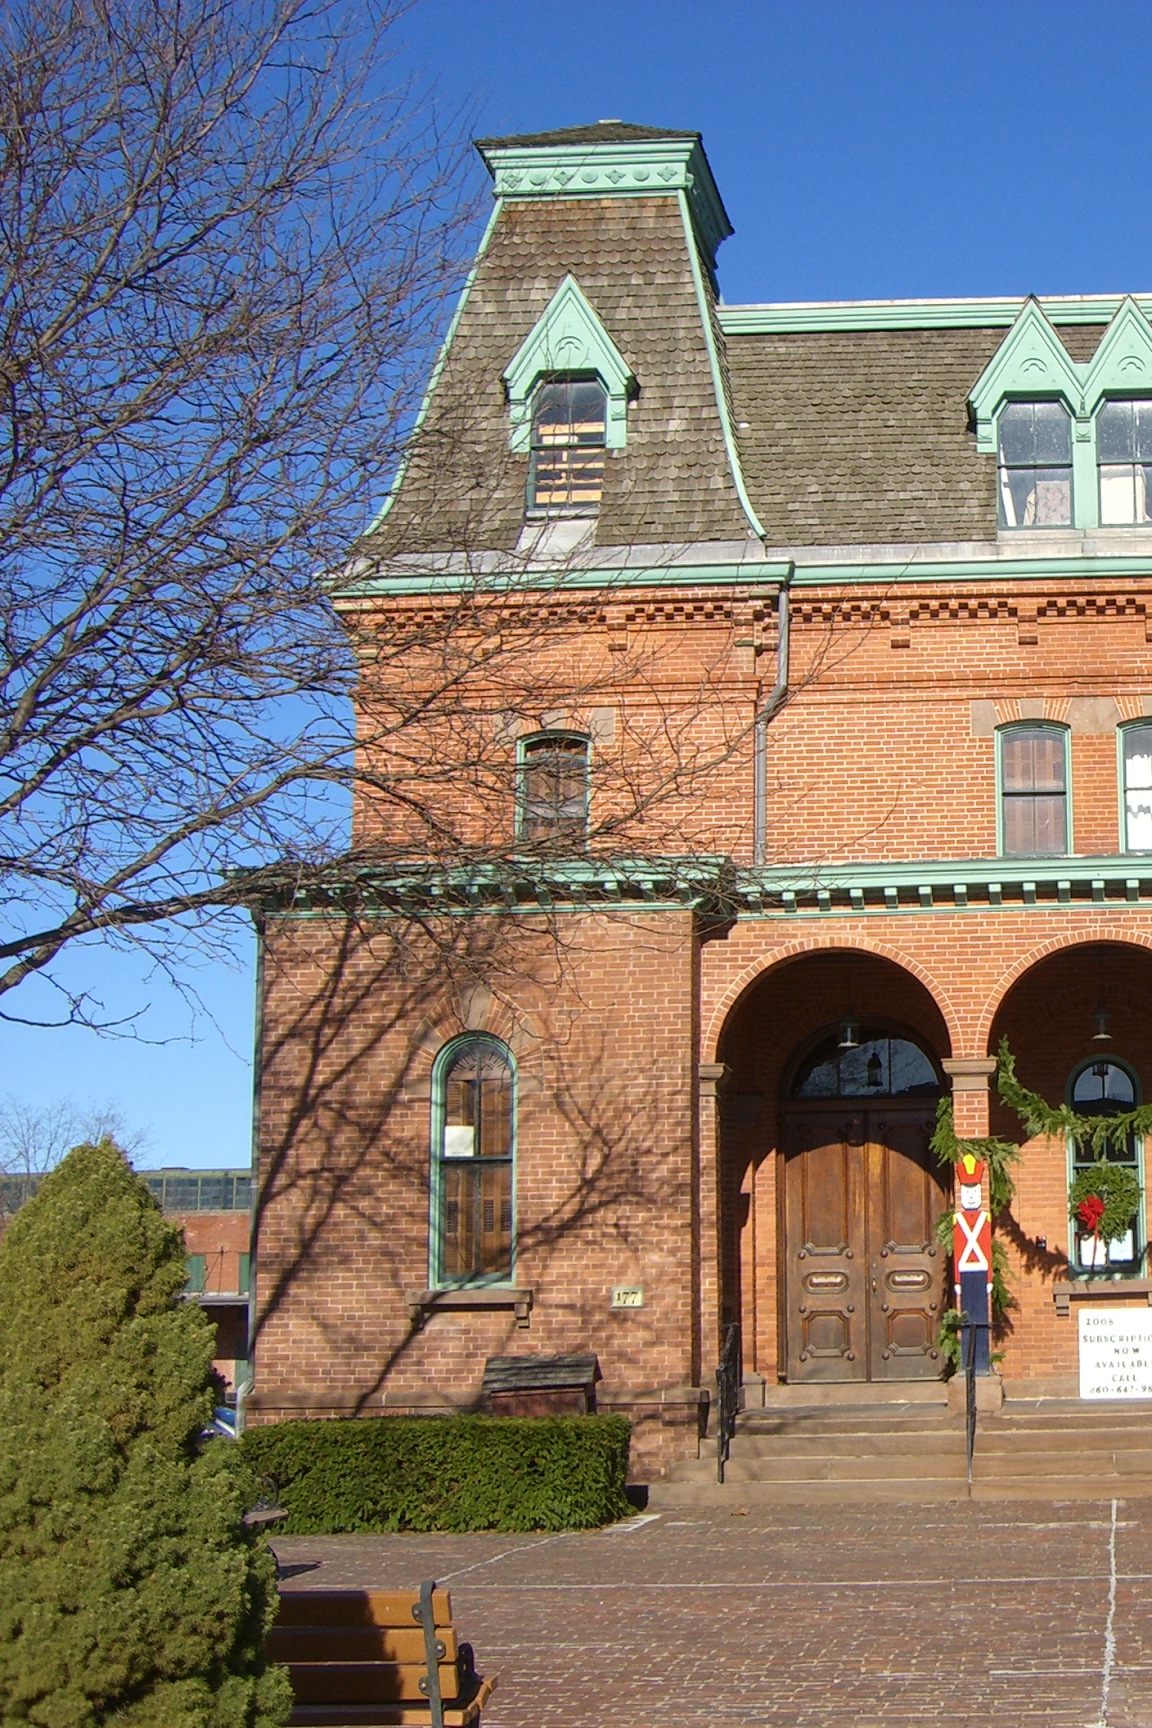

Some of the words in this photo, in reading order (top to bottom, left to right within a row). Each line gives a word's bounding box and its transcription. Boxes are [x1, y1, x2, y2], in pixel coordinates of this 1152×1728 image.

[616, 1291, 639, 1304] 177
[1086, 1318, 1114, 1326] 2008
[1112, 1374, 1138, 1382] CALL
